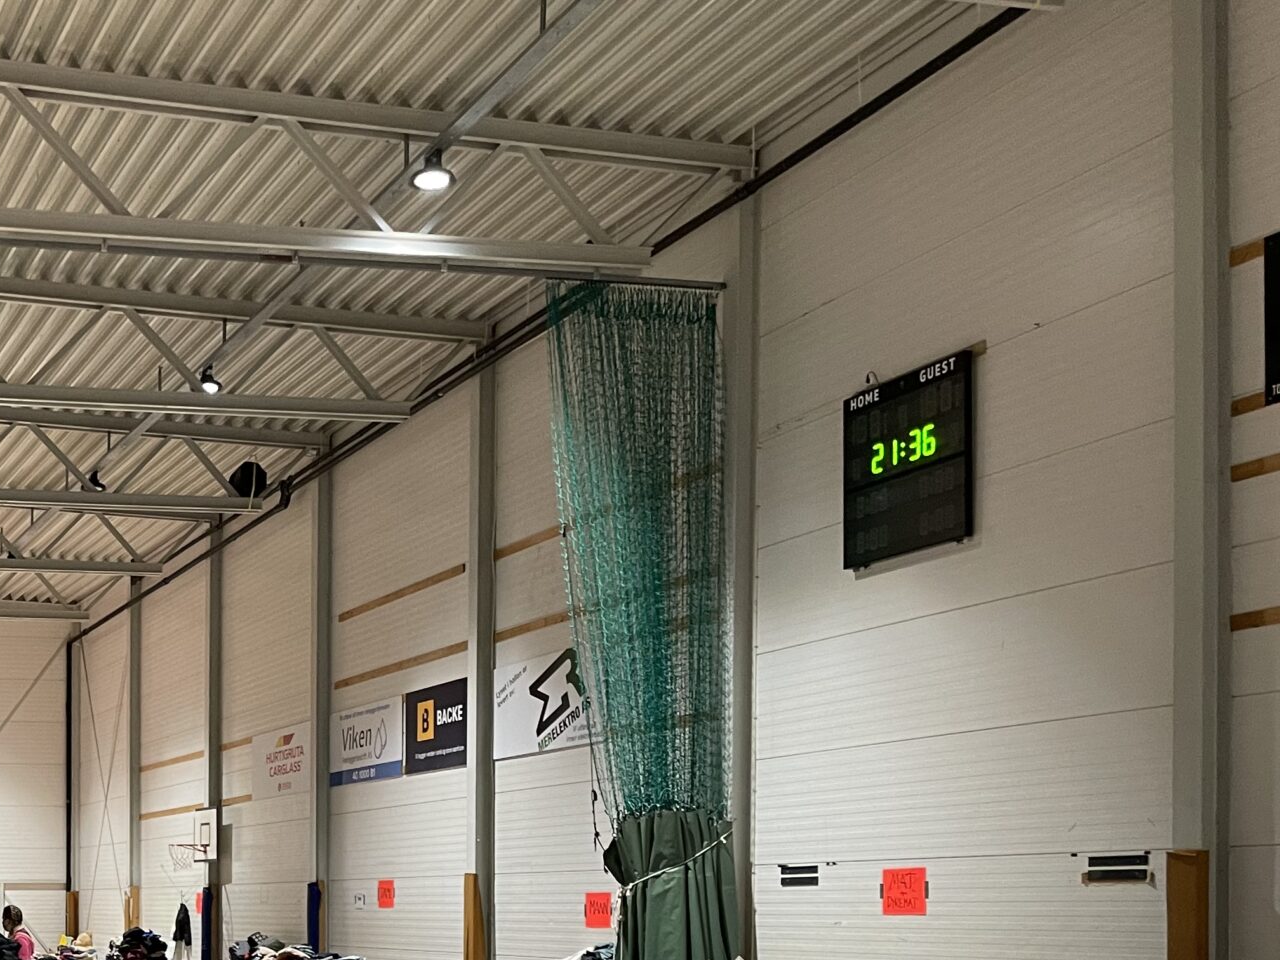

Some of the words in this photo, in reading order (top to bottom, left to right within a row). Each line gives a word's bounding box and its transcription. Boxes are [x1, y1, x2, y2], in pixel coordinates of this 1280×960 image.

[850, 389, 880, 411] HOME
[920, 357, 956, 382] GUEST
[871, 423, 937, 475] 21:36
[422, 708, 430, 734] B
[436, 704, 464, 726] BACKE
[342, 725, 372, 752] Viken
[266, 745, 305, 764] HURTIGRUTA
[269, 761, 302, 778] CARGLASS
[889, 872, 918, 891] MAT
[589, 898, 609, 915] MANN
